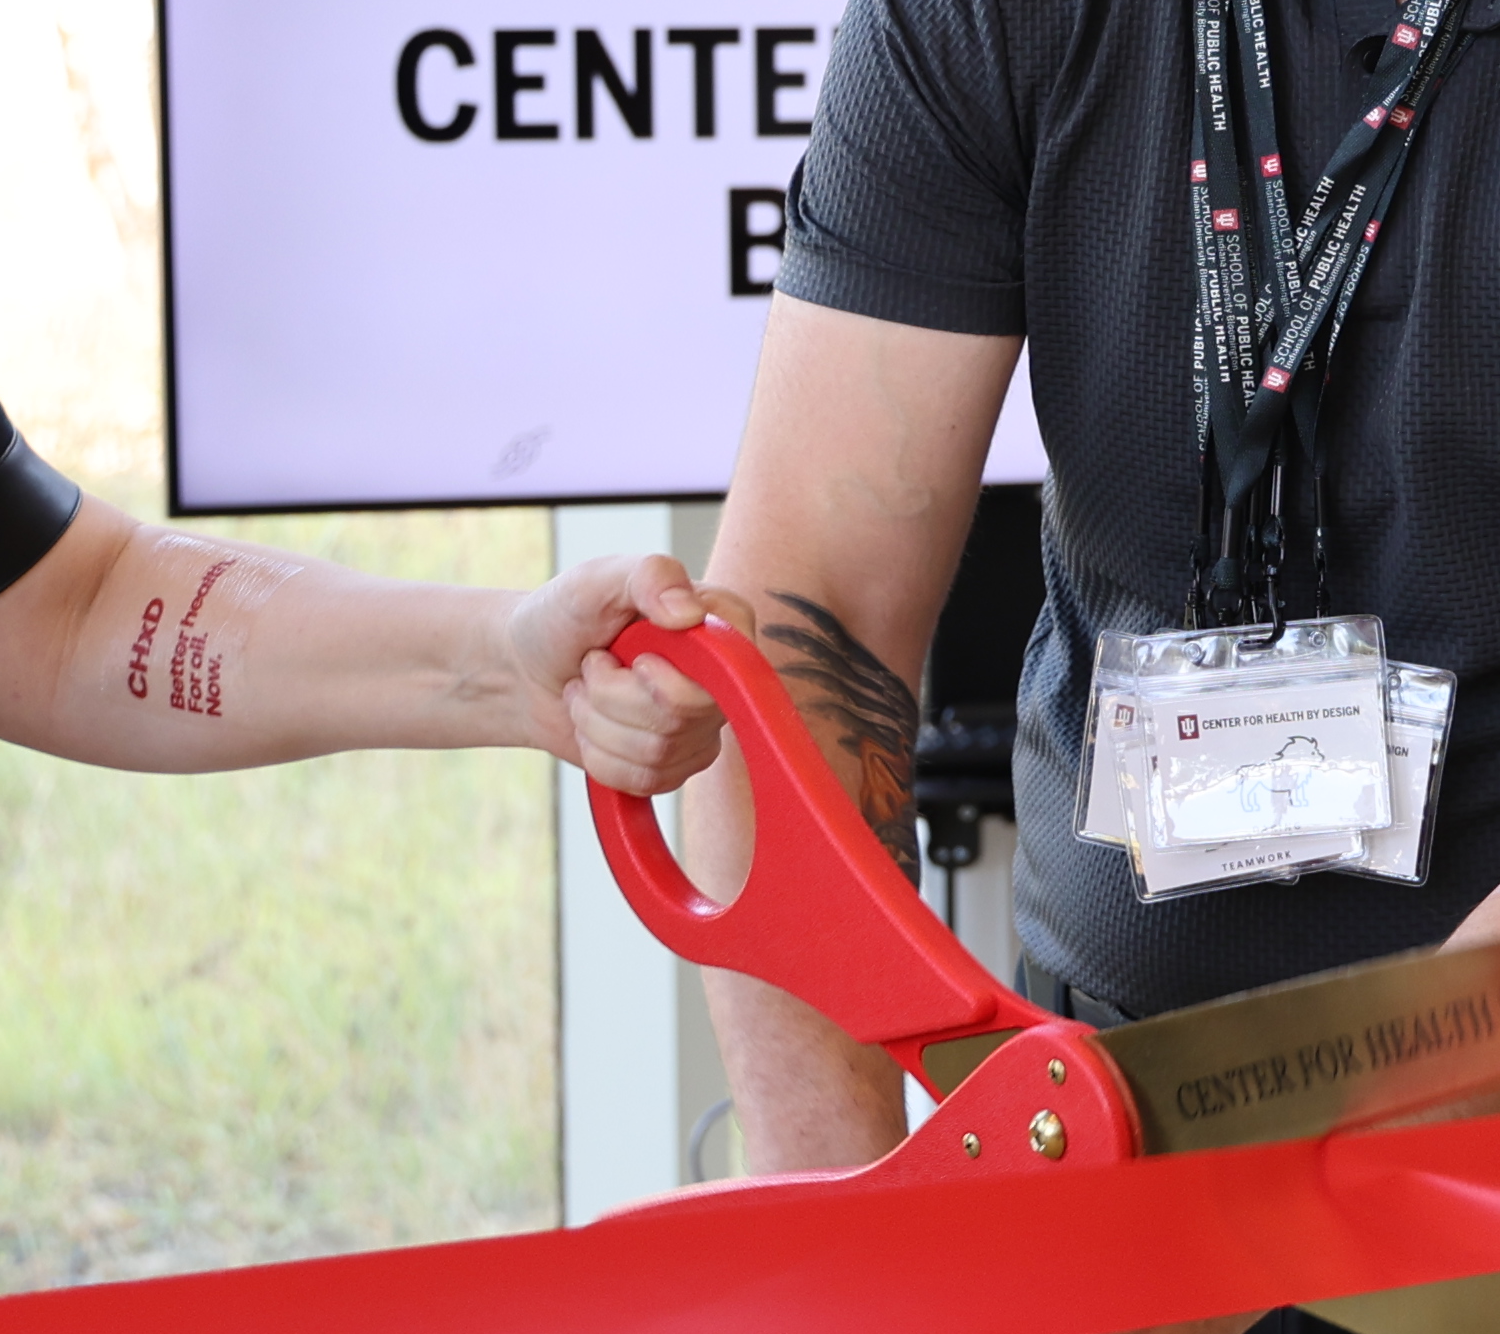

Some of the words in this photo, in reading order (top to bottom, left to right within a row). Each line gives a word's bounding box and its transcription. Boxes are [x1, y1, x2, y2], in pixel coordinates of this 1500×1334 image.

[1207, 0, 1220, 15] OF
[1197, 18, 1207, 74] Bloomington
[1207, 20, 1221, 71] PUBLIC
[1254, 31, 1271, 89] HEALTH
[1408, 75, 1430, 107] Indiana
[1426, 33, 1451, 75] University
[395, 26, 838, 144] CENTE
[1208, 74, 1227, 131] HEALTH
[1273, 179, 1291, 236] SCHOOL
[1302, 175, 1335, 228] HEALTH
[728, 188, 788, 298] B
[1195, 220, 1205, 266] University
[1216, 234, 1226, 267] Indiana
[1226, 234, 1245, 290] SCHOOL
[1269, 215, 1282, 260] University
[1281, 238, 1295, 255] OF
[1199, 268, 1212, 326] Bloomington
[1208, 269, 1223, 322] PUBLIC
[1221, 269, 1232, 315] University
[1273, 313, 1309, 365] SCHOOL
[1299, 291, 1317, 311] OF
[1309, 240, 1341, 290] PUBLIC
[1333, 184, 1367, 240] HEALTH
[1285, 260, 1302, 303] PUBL
[1233, 293, 1248, 311] OF
[1284, 336, 1305, 370] Indiana
[1300, 296, 1327, 338] University
[1320, 242, 1351, 295] Bloomington
[1226, 315, 1239, 371] Bloomington
[1236, 316, 1252, 367] PUBLIC
[1193, 374, 1204, 393] OF
[1241, 370, 1256, 408] HEAL
[170, 630, 190, 711] Better
[189, 632, 209, 669] all.
[188, 672, 203, 714] For
[205, 653, 223, 718] Now.
[1202, 718, 1241, 731] CENTER
[1243, 715, 1264, 727] FOR
[1266, 711, 1305, 724] HEALTH
[1306, 709, 1321, 720] BY
[1322, 706, 1361, 719] DESIGN
[1221, 850, 1293, 873] TEAMWORK
[1176, 1055, 1296, 1121] CENTER
[1298, 1036, 1362, 1090] FOR
[1365, 994, 1495, 1071] HEALTH
